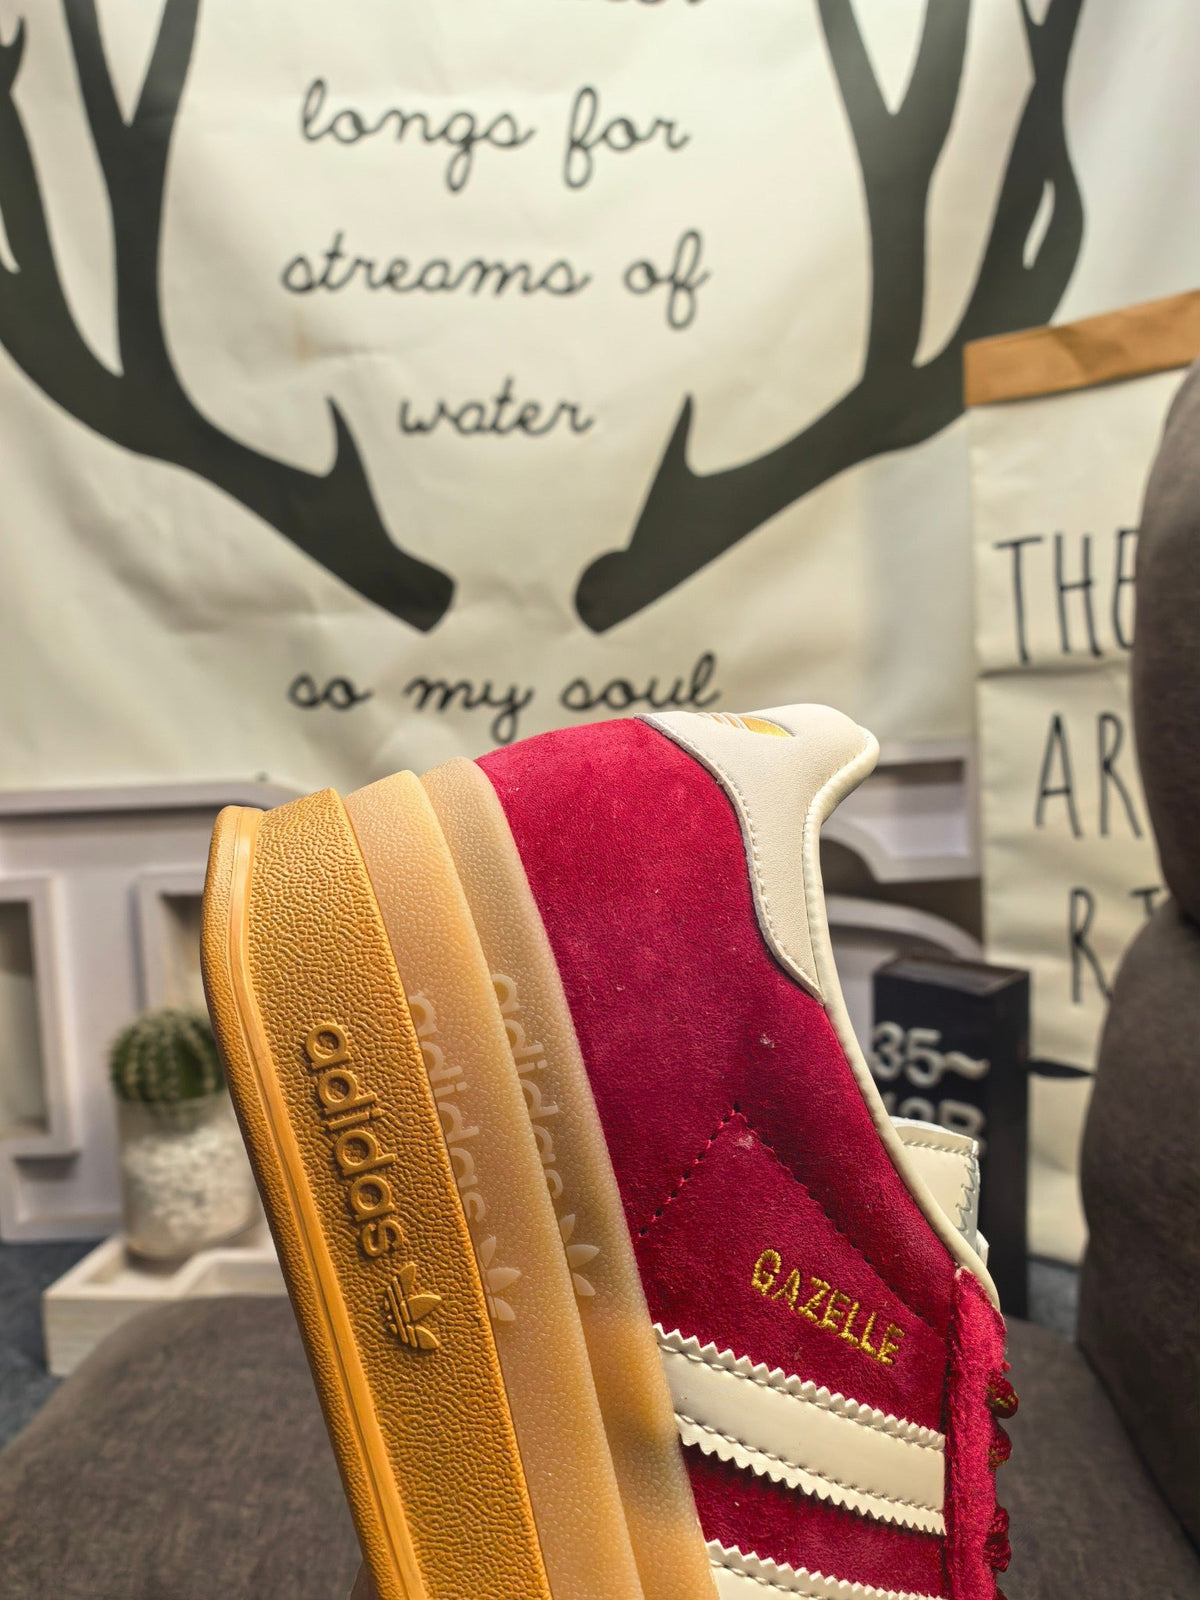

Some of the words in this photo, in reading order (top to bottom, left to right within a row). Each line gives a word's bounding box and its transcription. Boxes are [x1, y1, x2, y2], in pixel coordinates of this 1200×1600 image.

[301, 77, 536, 193] longs
[563, 86, 690, 190] for
[281, 231, 591, 296] streams
[623, 229, 711, 331] of
[398, 377, 594, 437] water
[288, 674, 373, 711] so
[402, 676, 534, 744] my
[559, 652, 721, 713] soul
[305, 1021, 402, 1258] adidas
[751, 1248, 905, 1366] GAZELLE
